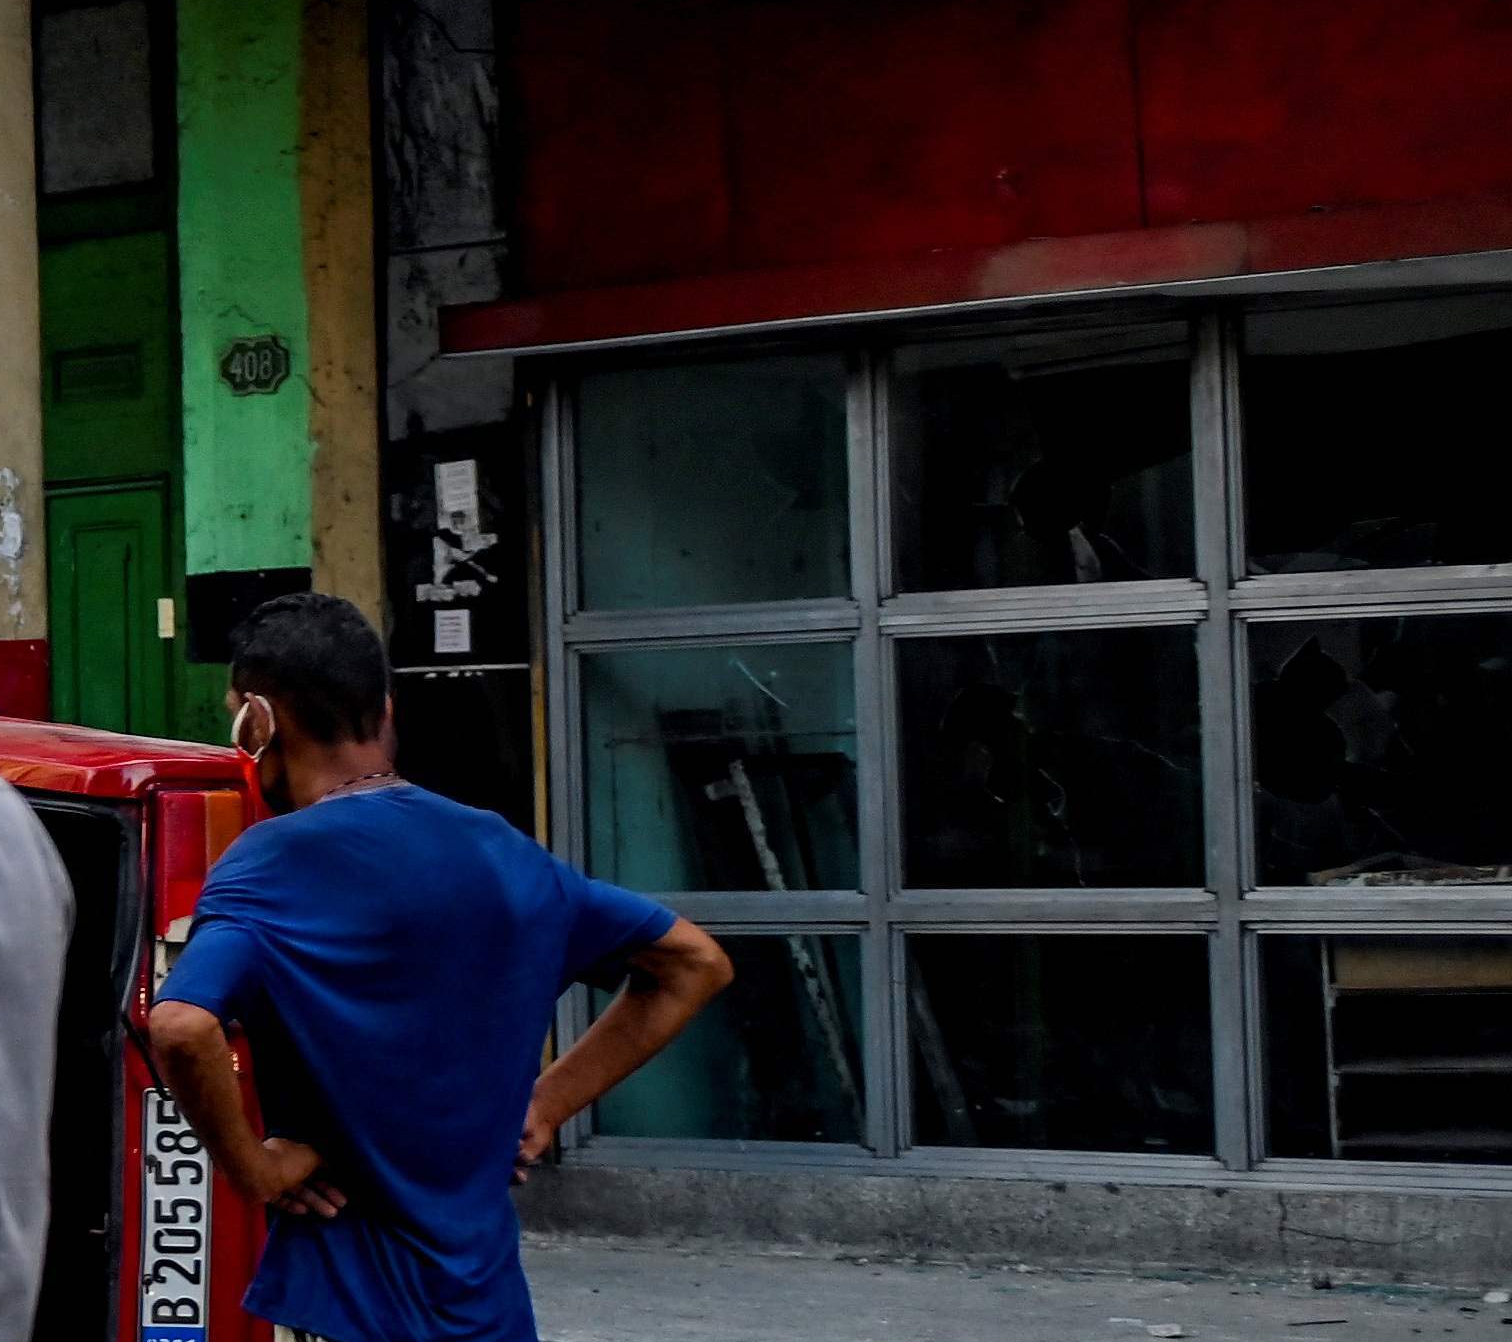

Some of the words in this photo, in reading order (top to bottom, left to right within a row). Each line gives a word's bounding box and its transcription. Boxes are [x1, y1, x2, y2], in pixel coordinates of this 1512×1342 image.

[230, 348, 273, 383] 408
[152, 1198, 203, 1286] 205
[151, 1296, 200, 1325] B
